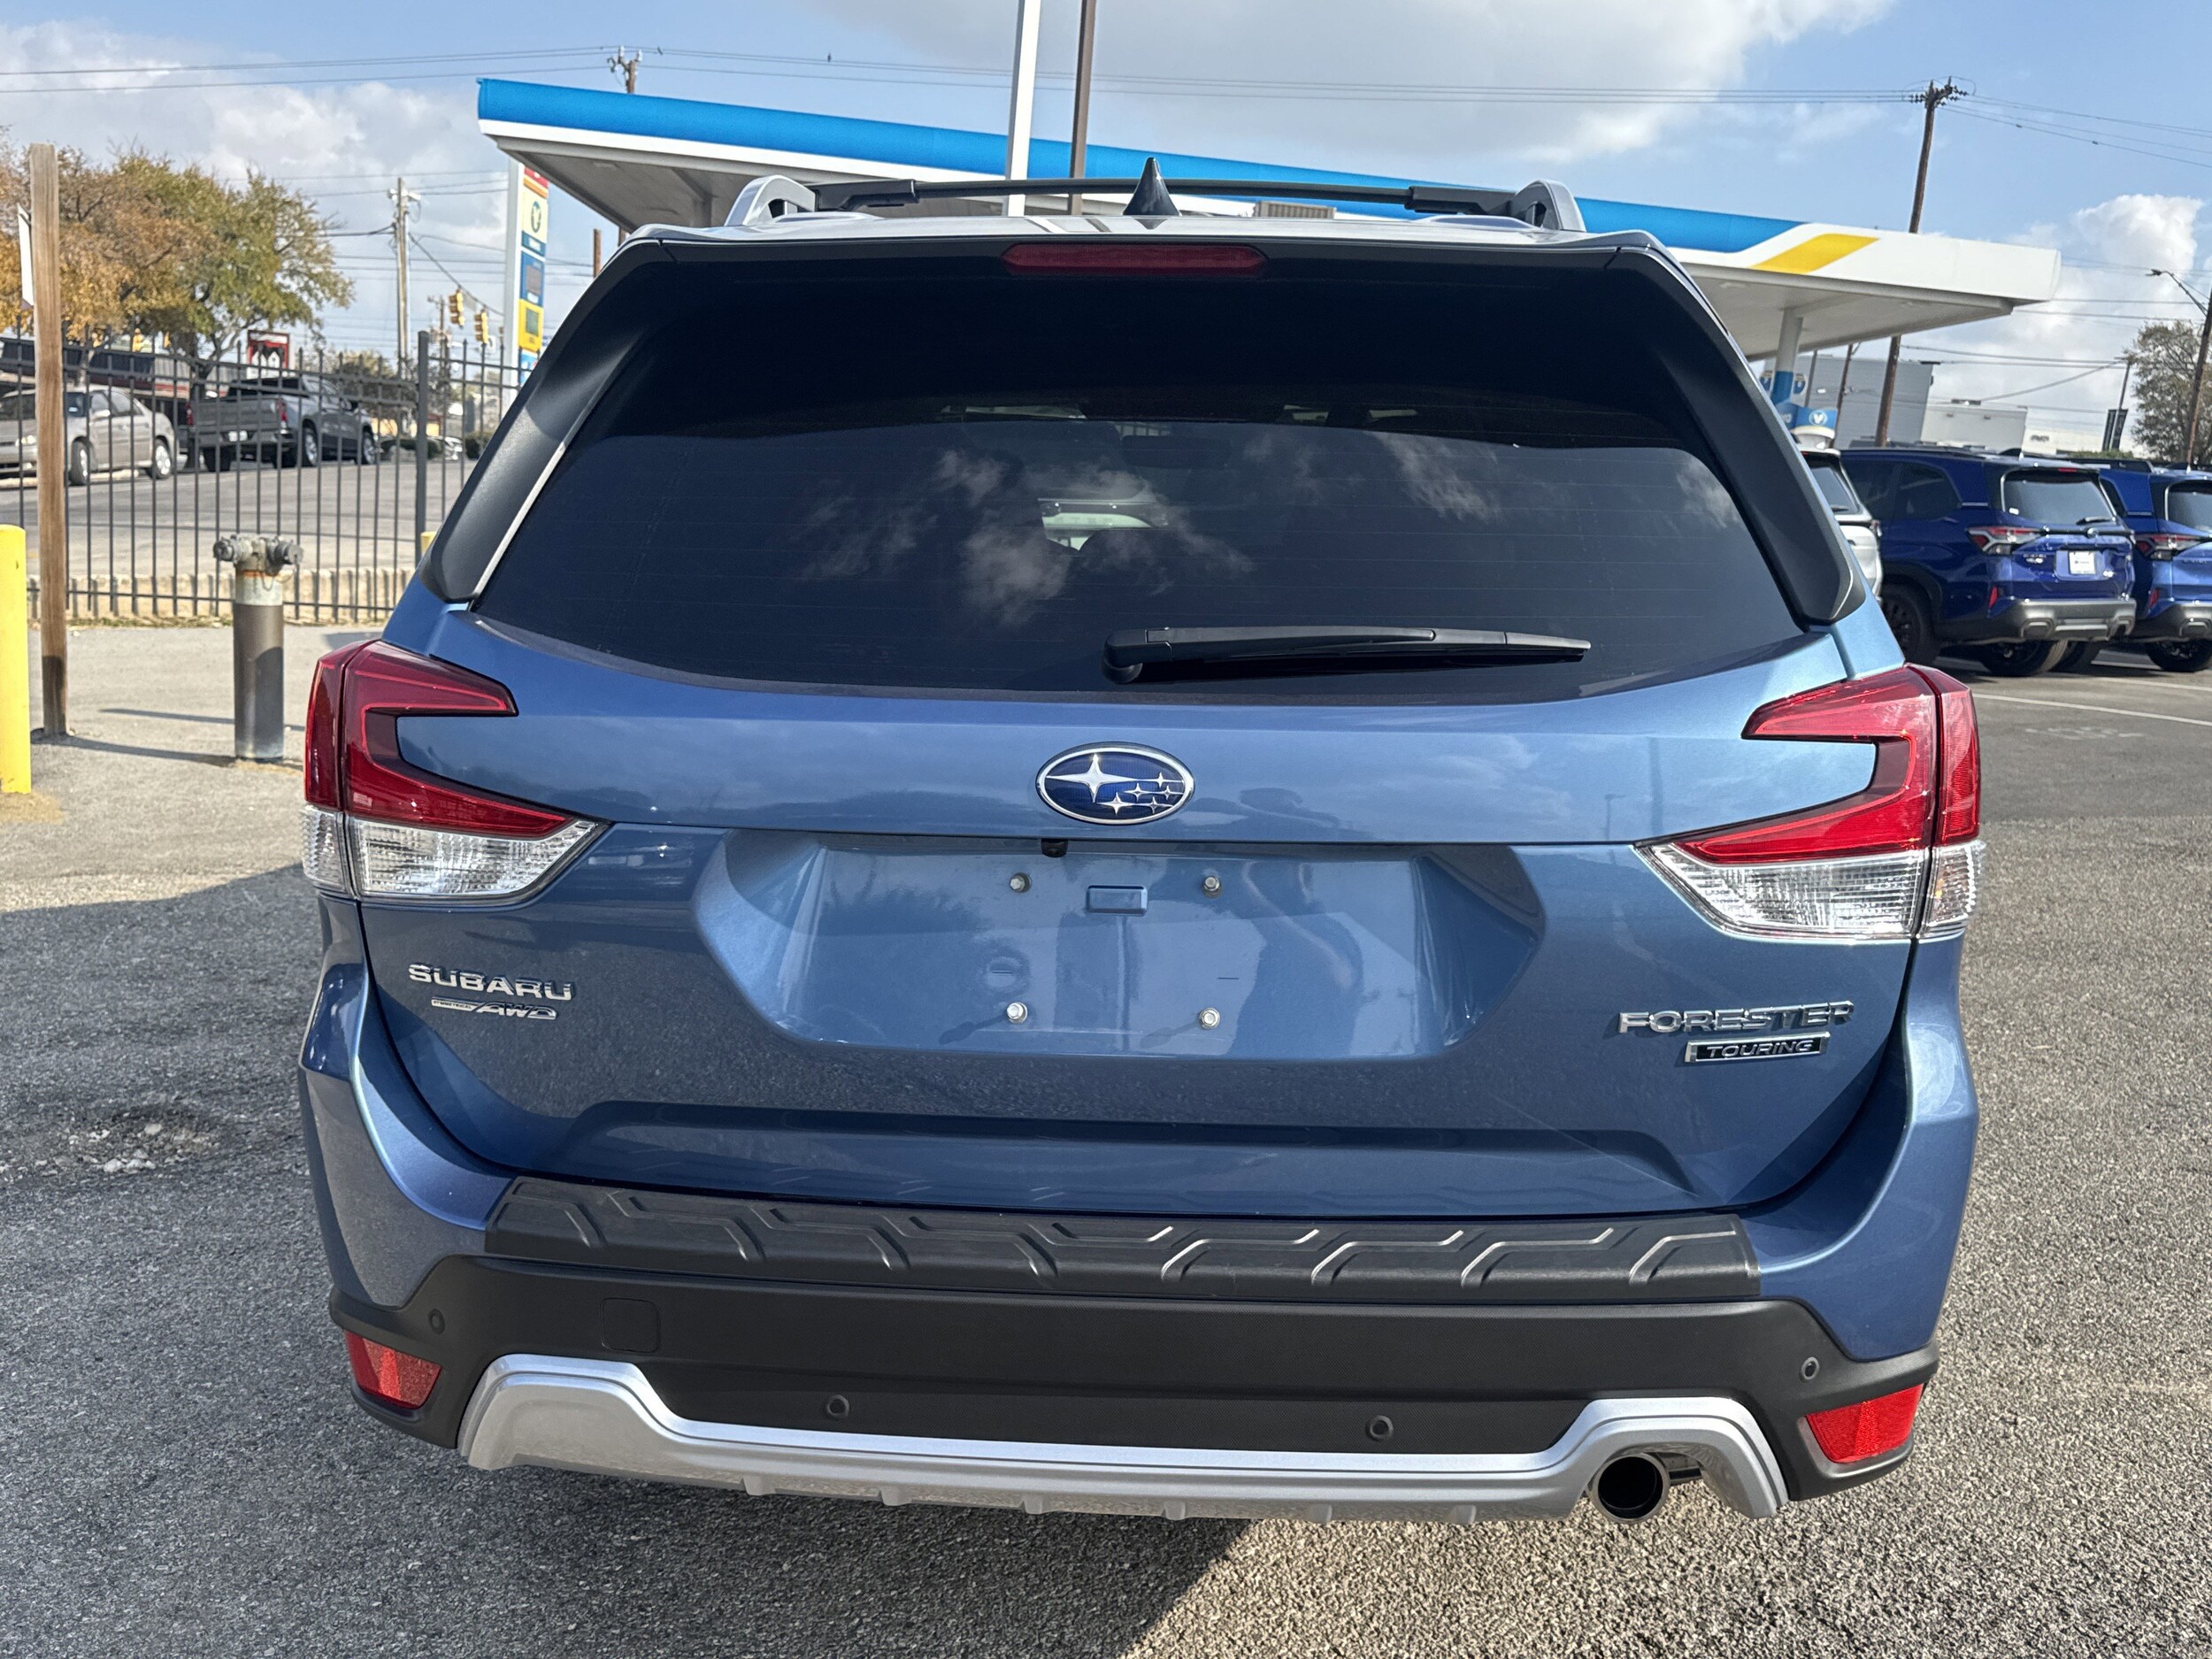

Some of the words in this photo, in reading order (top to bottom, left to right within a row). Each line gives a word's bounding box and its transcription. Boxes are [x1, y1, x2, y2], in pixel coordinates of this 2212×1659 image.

[408, 962, 573, 1001] SUBARU
[433, 999, 472, 1010] SYMMETRICAL
[476, 1002, 557, 1020] AWD
[1618, 1000, 1855, 1033] FORESTER
[1706, 1039, 1814, 1058] TOURING
